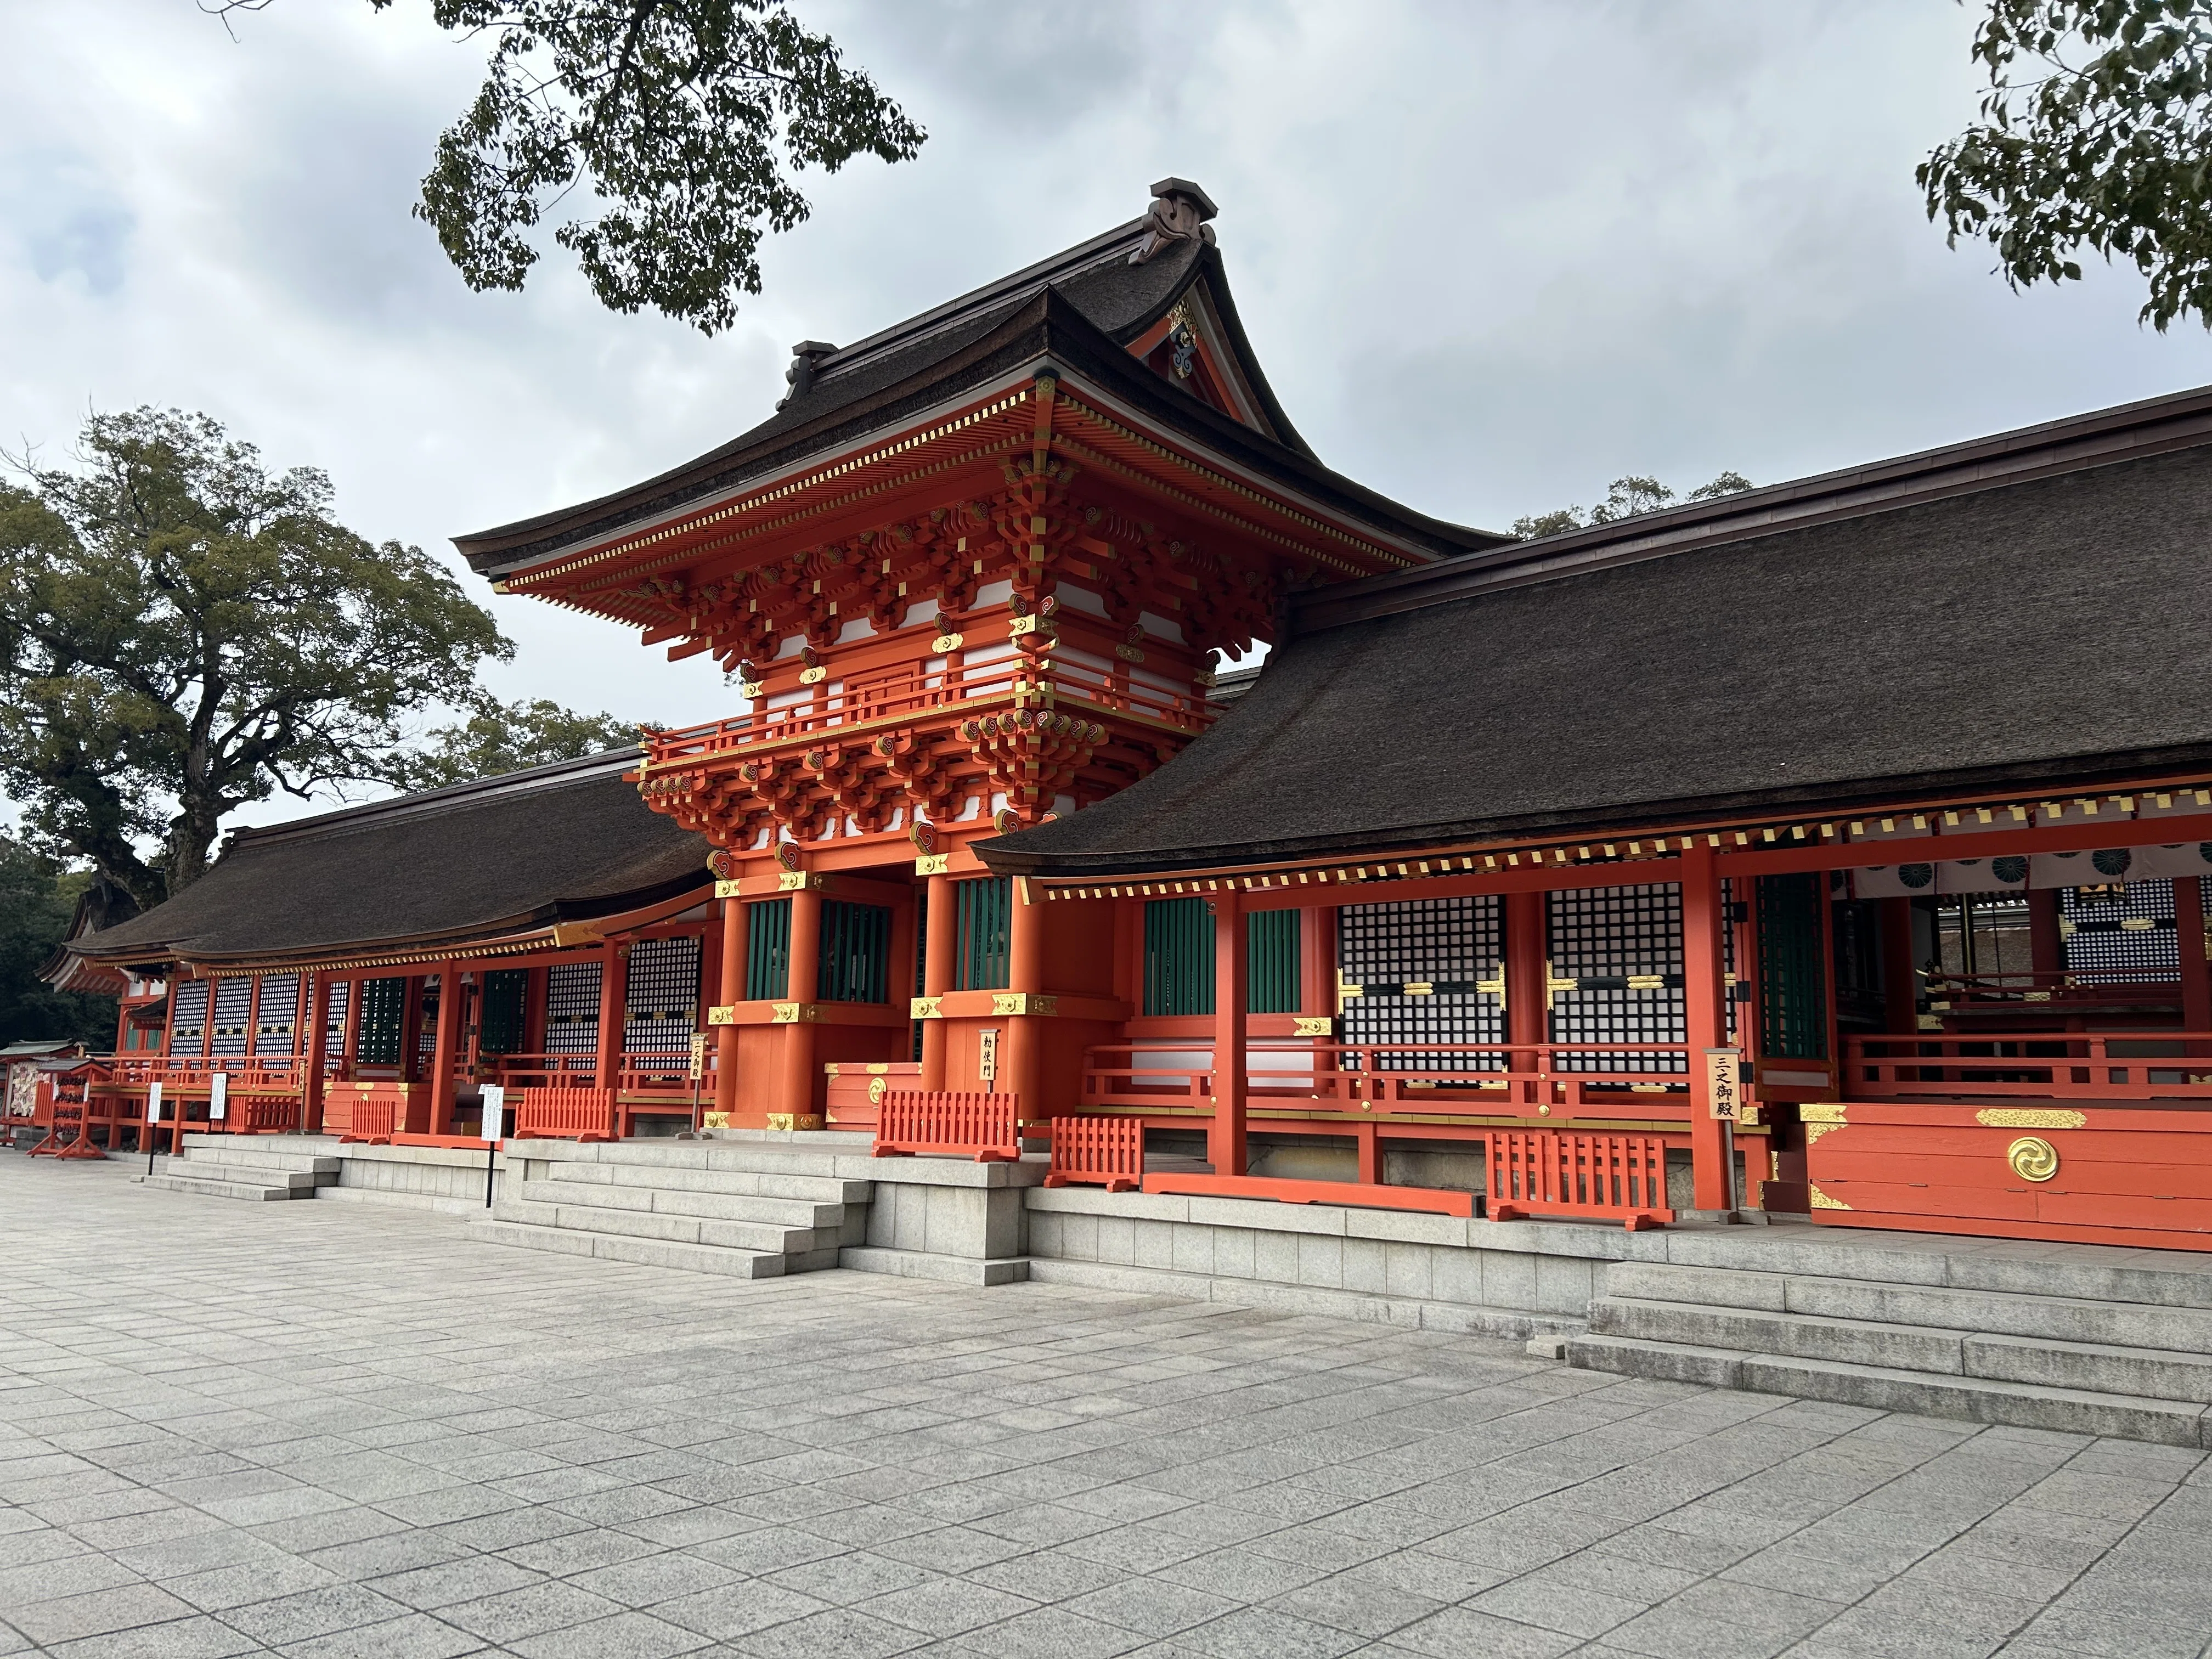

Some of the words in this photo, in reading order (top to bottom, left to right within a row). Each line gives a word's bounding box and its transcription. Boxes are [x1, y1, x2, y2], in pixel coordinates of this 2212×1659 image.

[692, 1042, 701, 1077] 二之御殿
[983, 1035, 992, 1077] 勅使門
[1714, 1057, 1735, 1116] 三之御殿
